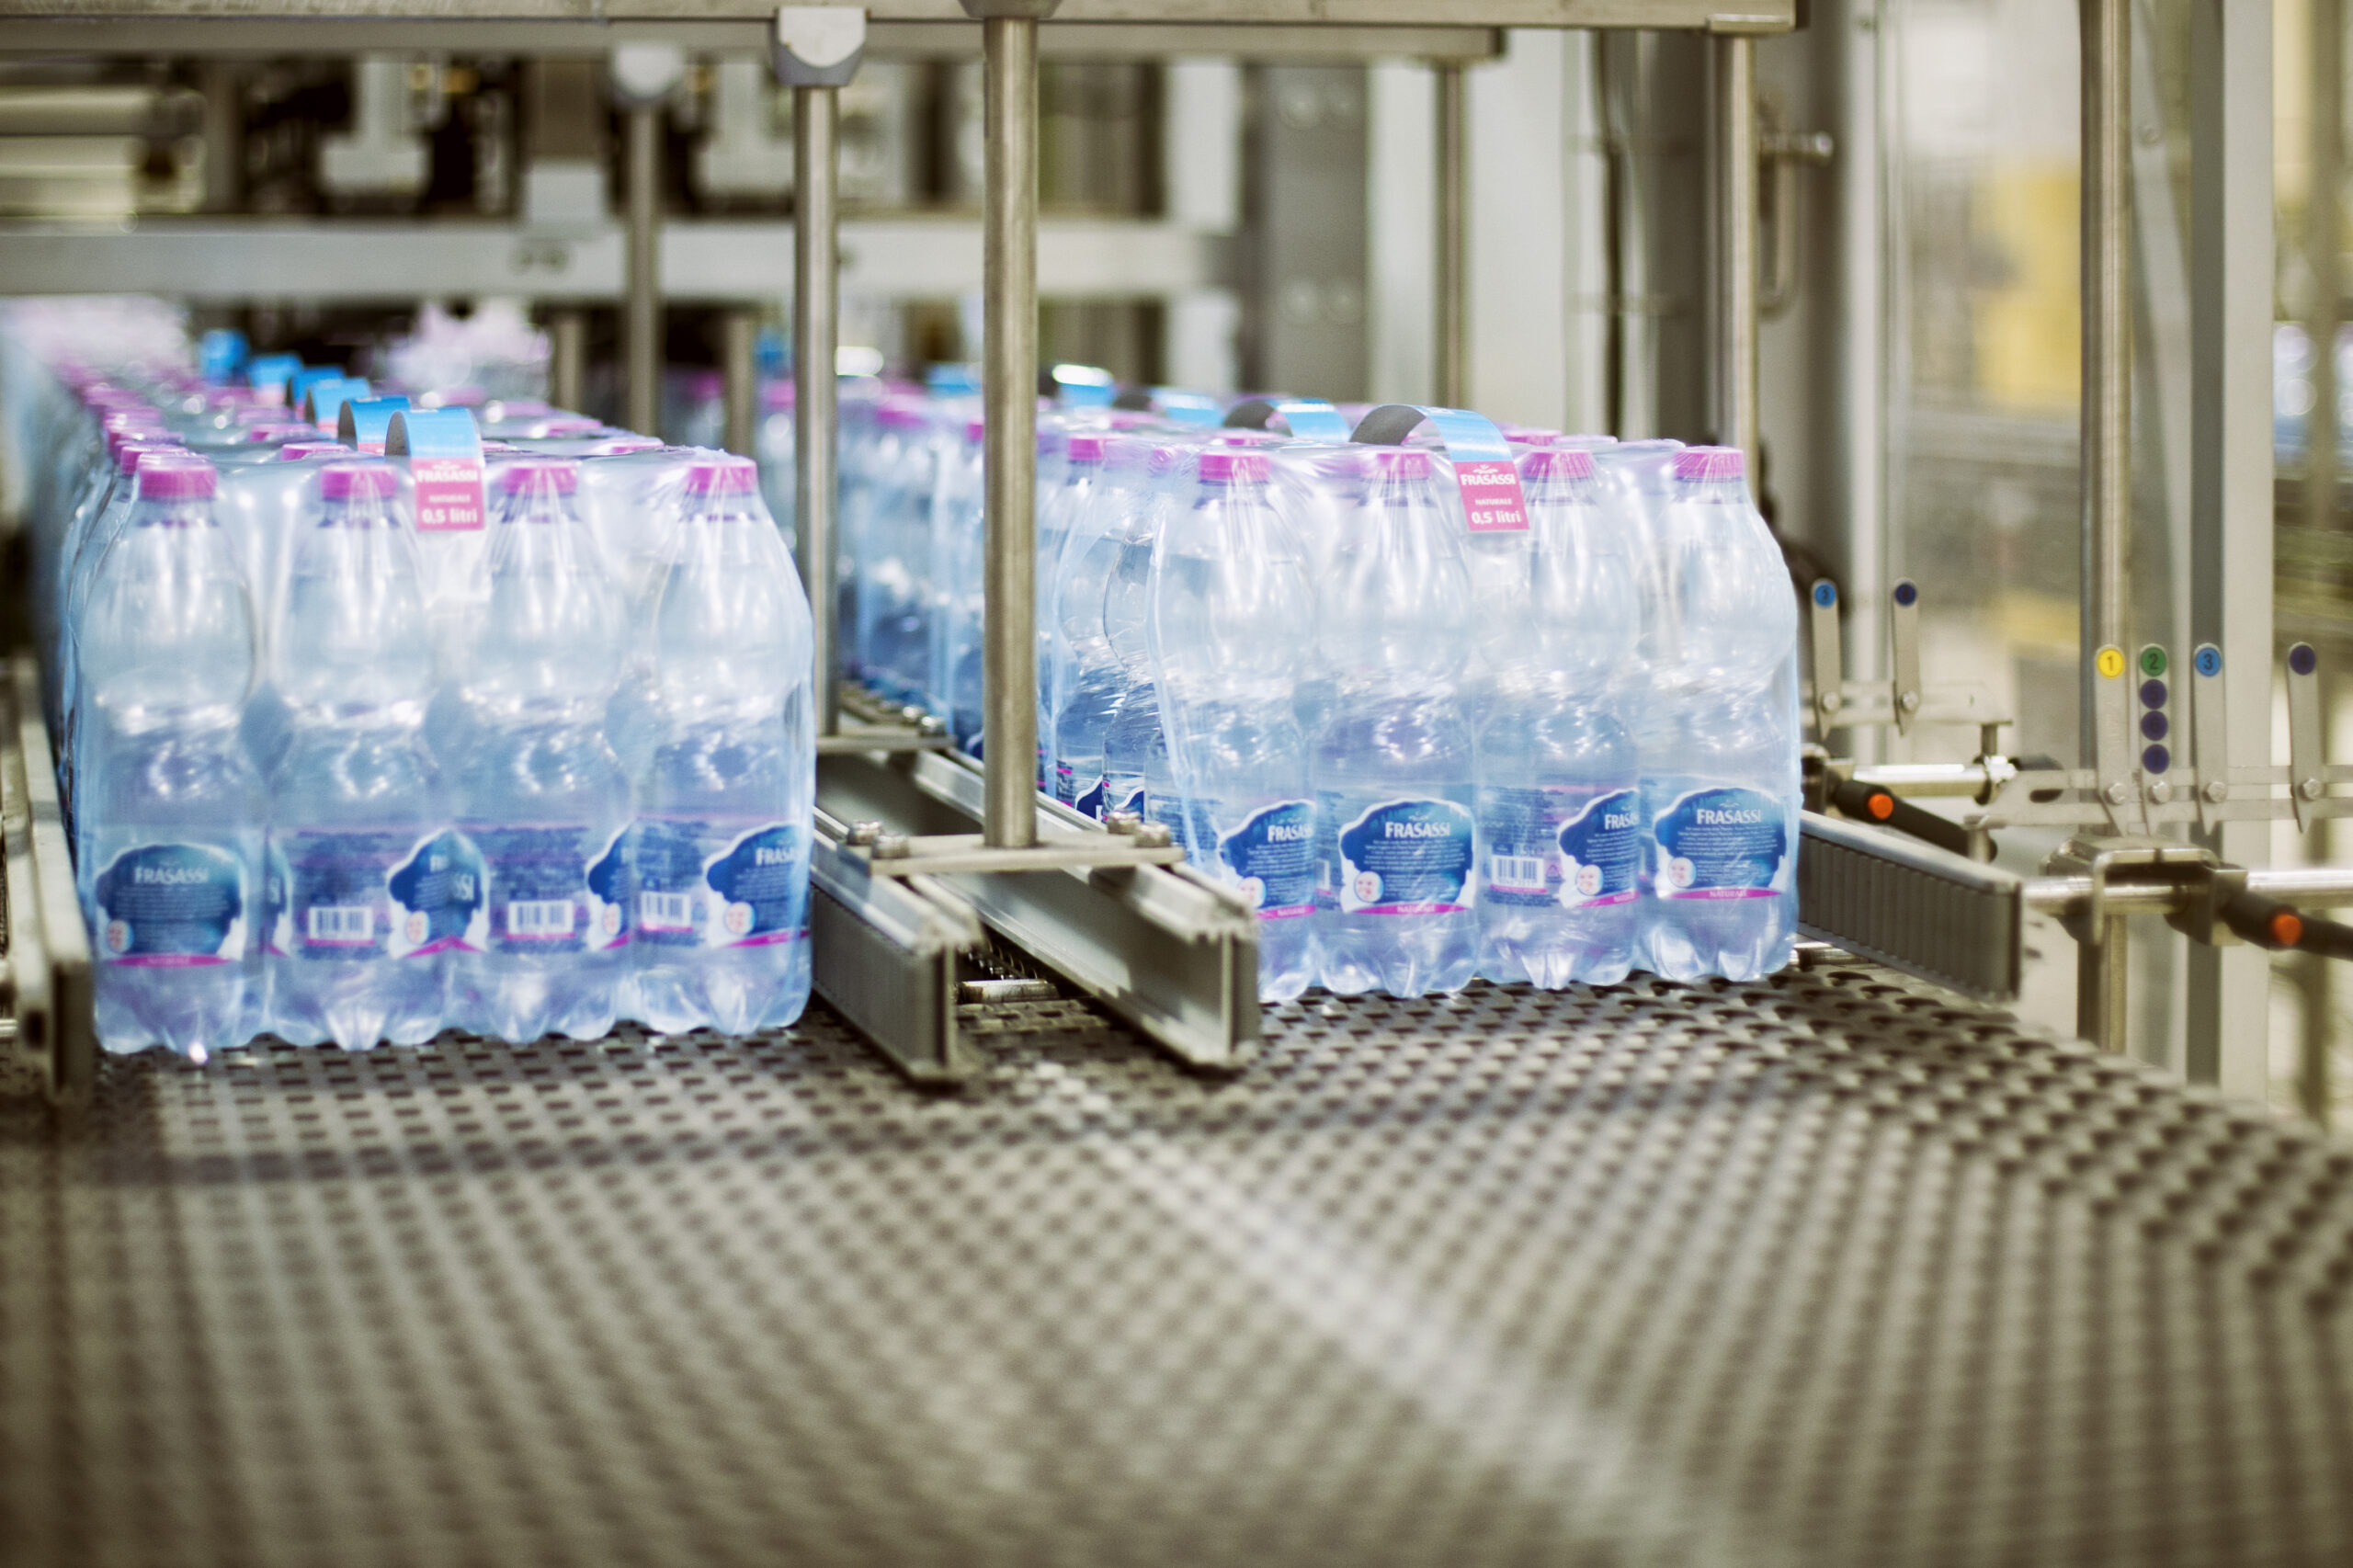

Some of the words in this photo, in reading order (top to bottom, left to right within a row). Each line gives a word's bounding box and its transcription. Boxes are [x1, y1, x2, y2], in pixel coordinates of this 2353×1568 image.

[416, 470, 478, 483] FRASASSI
[1460, 473, 1517, 485] FRASASSI
[1474, 497, 1512, 506] NATURALE
[449, 507, 478, 523] litri
[1471, 511, 1493, 525] 0,5
[1495, 509, 1521, 523] litri
[2106, 654, 2114, 672] 1
[2148, 653, 2160, 670] 2
[2203, 653, 2213, 671] 3
[1696, 808, 1762, 824] FRASASSI
[1384, 821, 1451, 838] FRASASSI
[133, 867, 210, 884] FRASASSI
